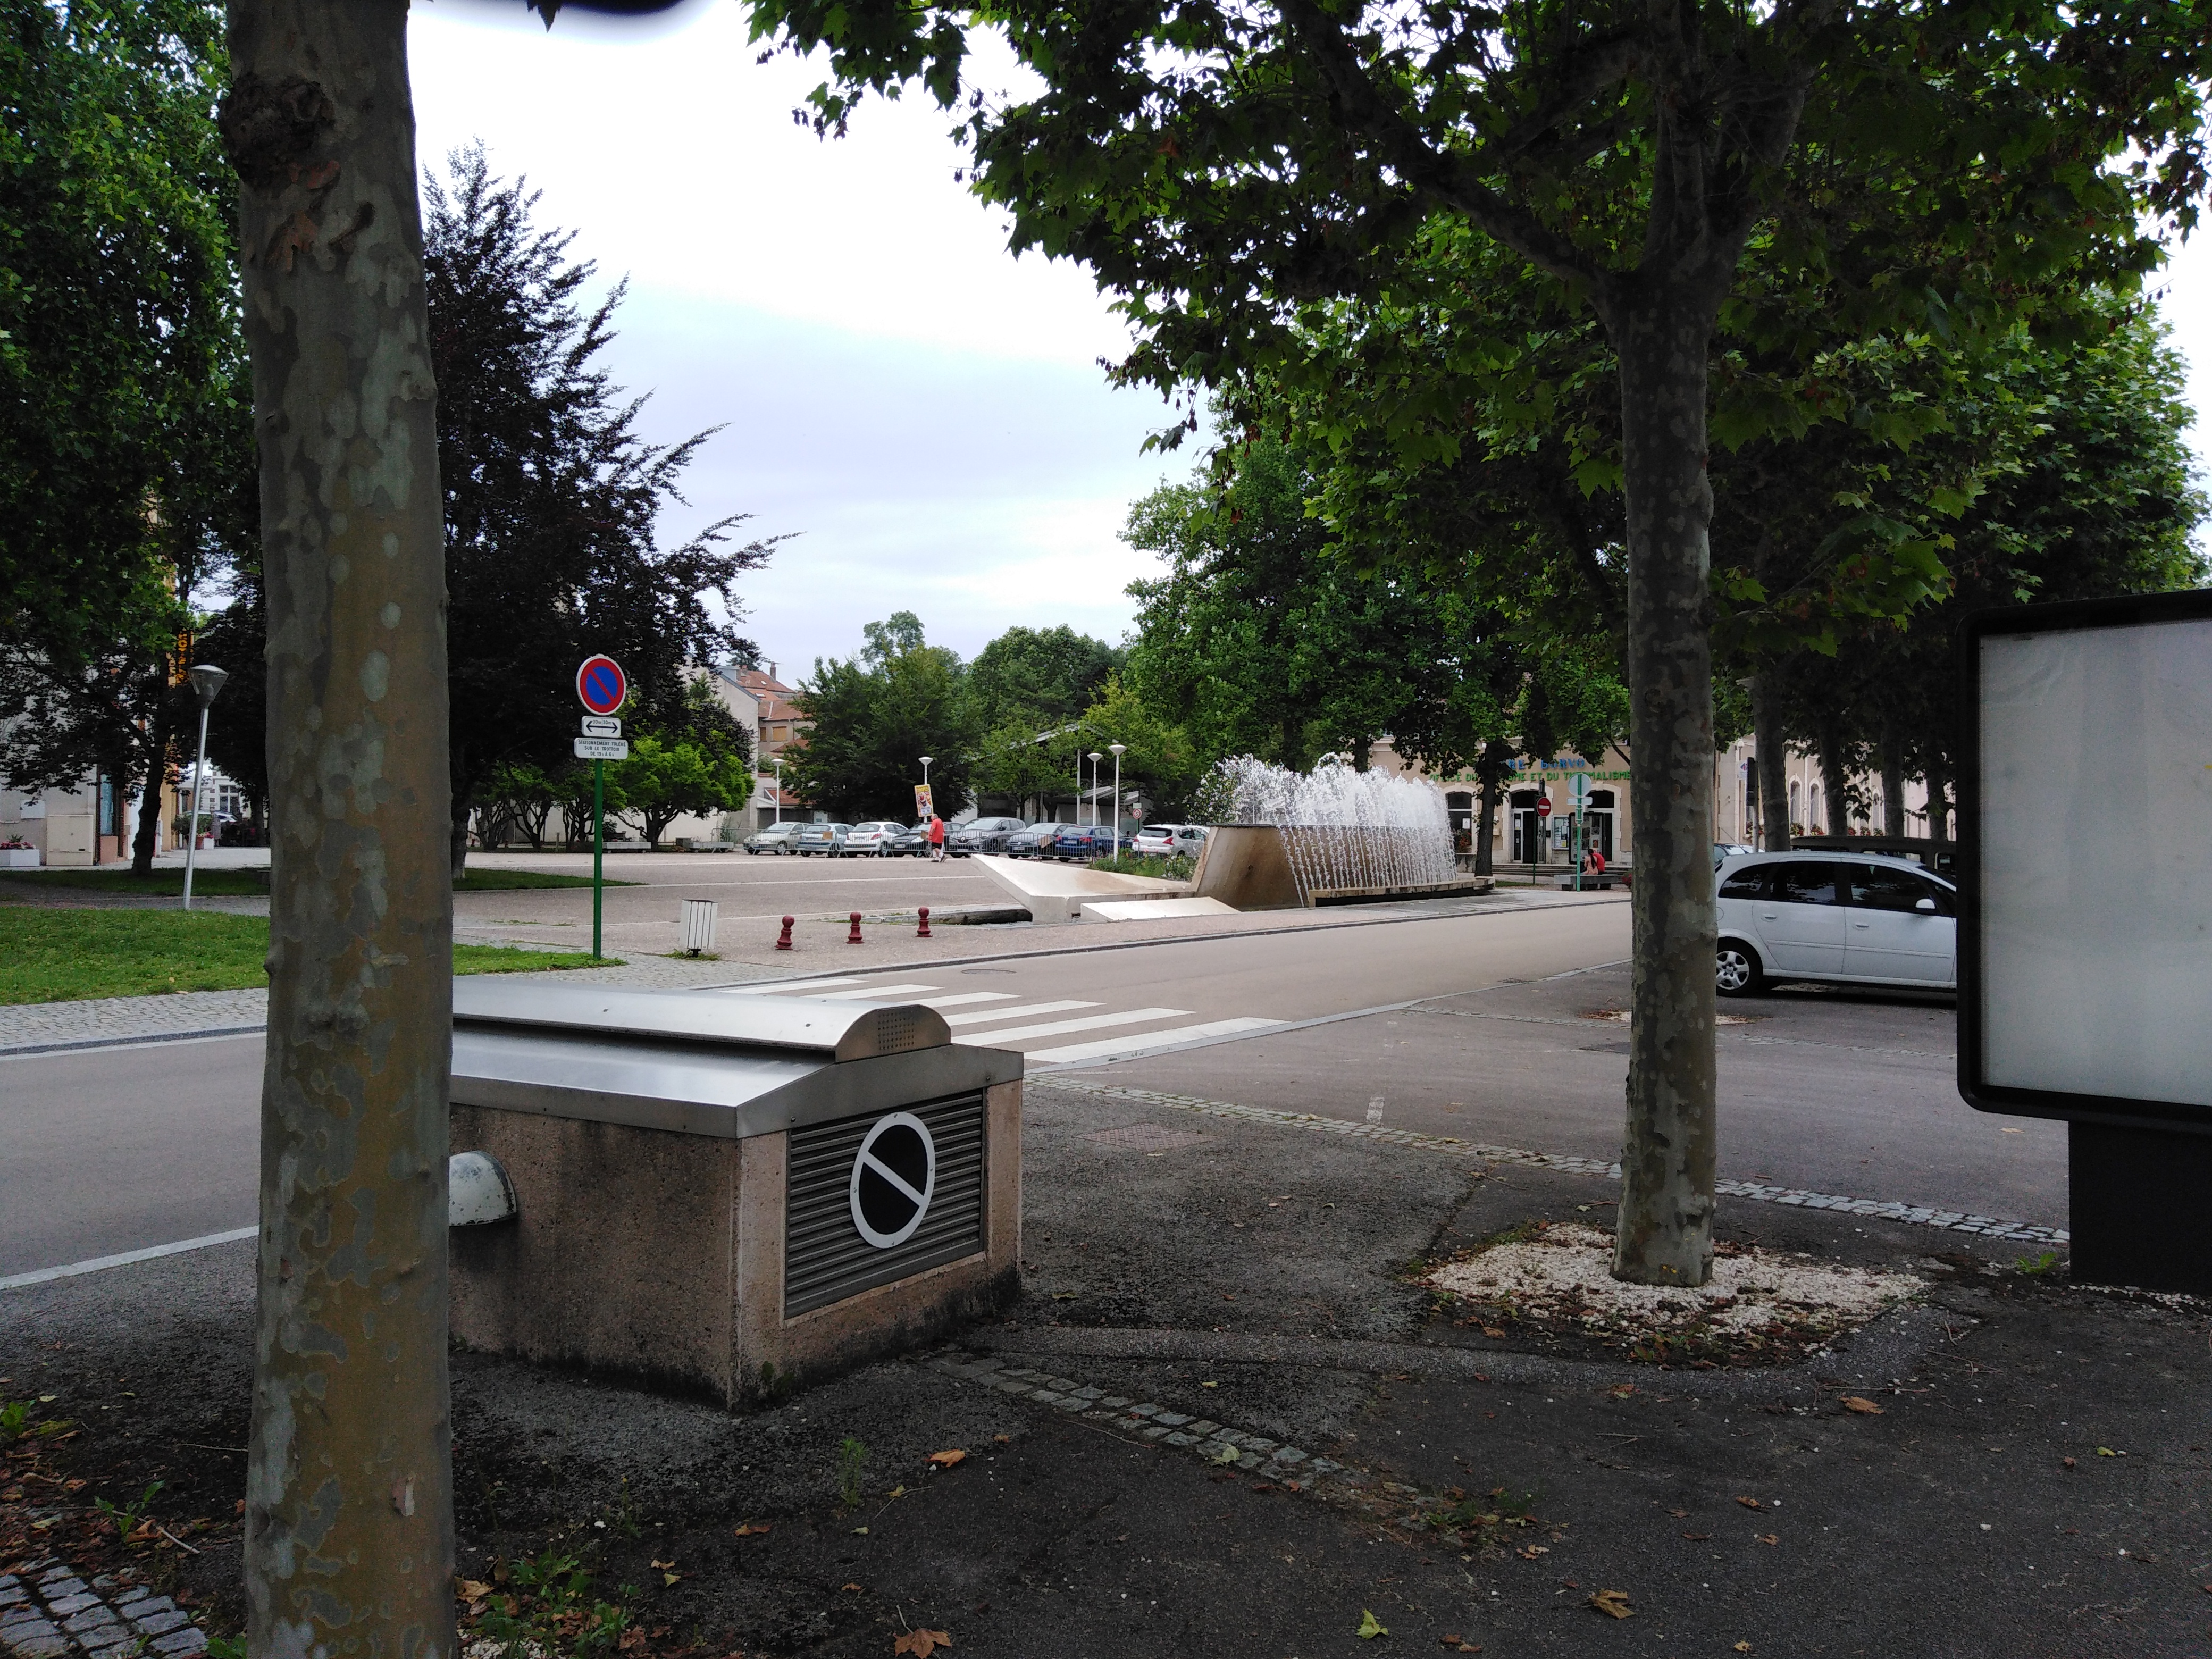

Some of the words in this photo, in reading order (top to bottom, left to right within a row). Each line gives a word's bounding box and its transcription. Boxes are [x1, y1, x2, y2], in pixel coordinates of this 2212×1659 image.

[1530, 772, 1541, 781] ET
[1546, 772, 1559, 781] DU
[1563, 770, 1630, 780] THMALISME
